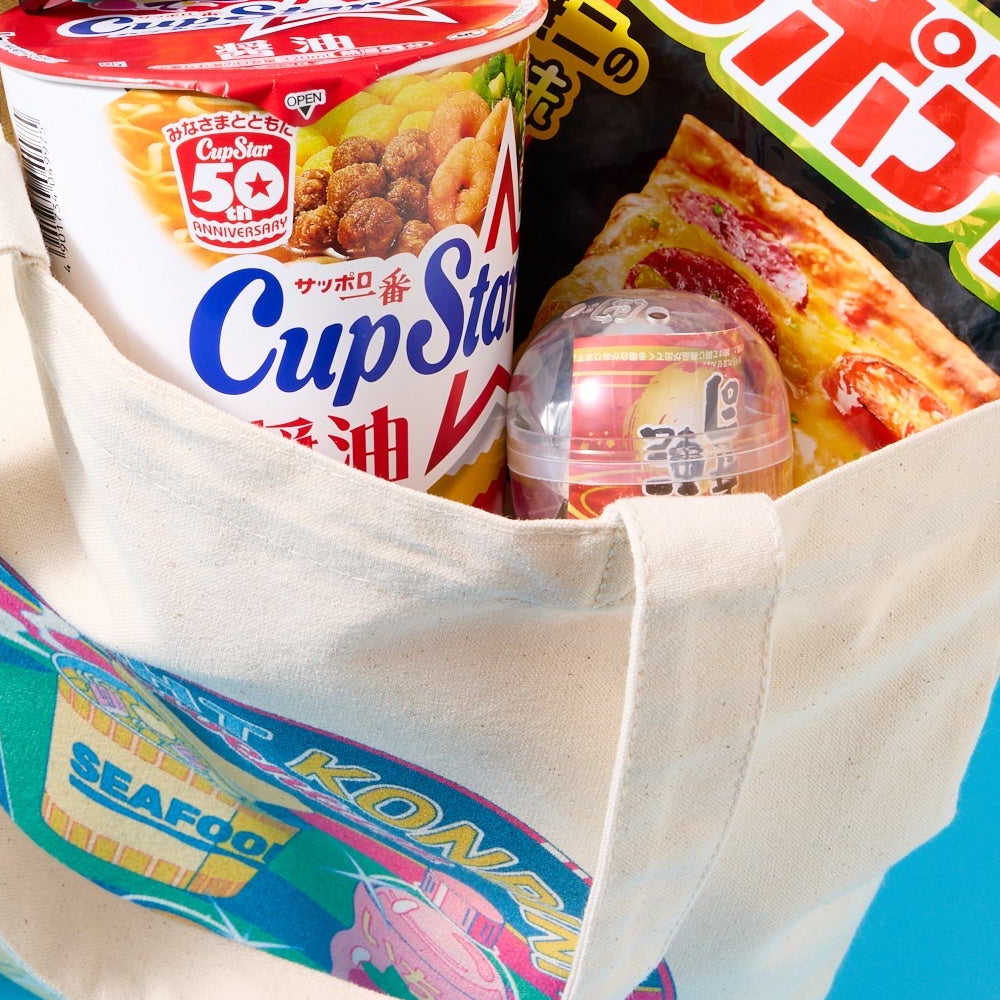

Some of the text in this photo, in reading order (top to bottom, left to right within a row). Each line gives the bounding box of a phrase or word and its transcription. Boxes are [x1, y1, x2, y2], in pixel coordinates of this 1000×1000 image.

[214, 33, 356, 61] 醤油
[287, 92, 322, 107] OPEN
[166, 114, 294, 143] みなさまとともに
[191, 160, 285, 213] 50
[192, 216, 288, 238] ANNIVERSARY
[225, 205, 253, 222] th
[293, 267, 411, 307] サッポロ一番
[285, 748, 584, 981] KONBIN
